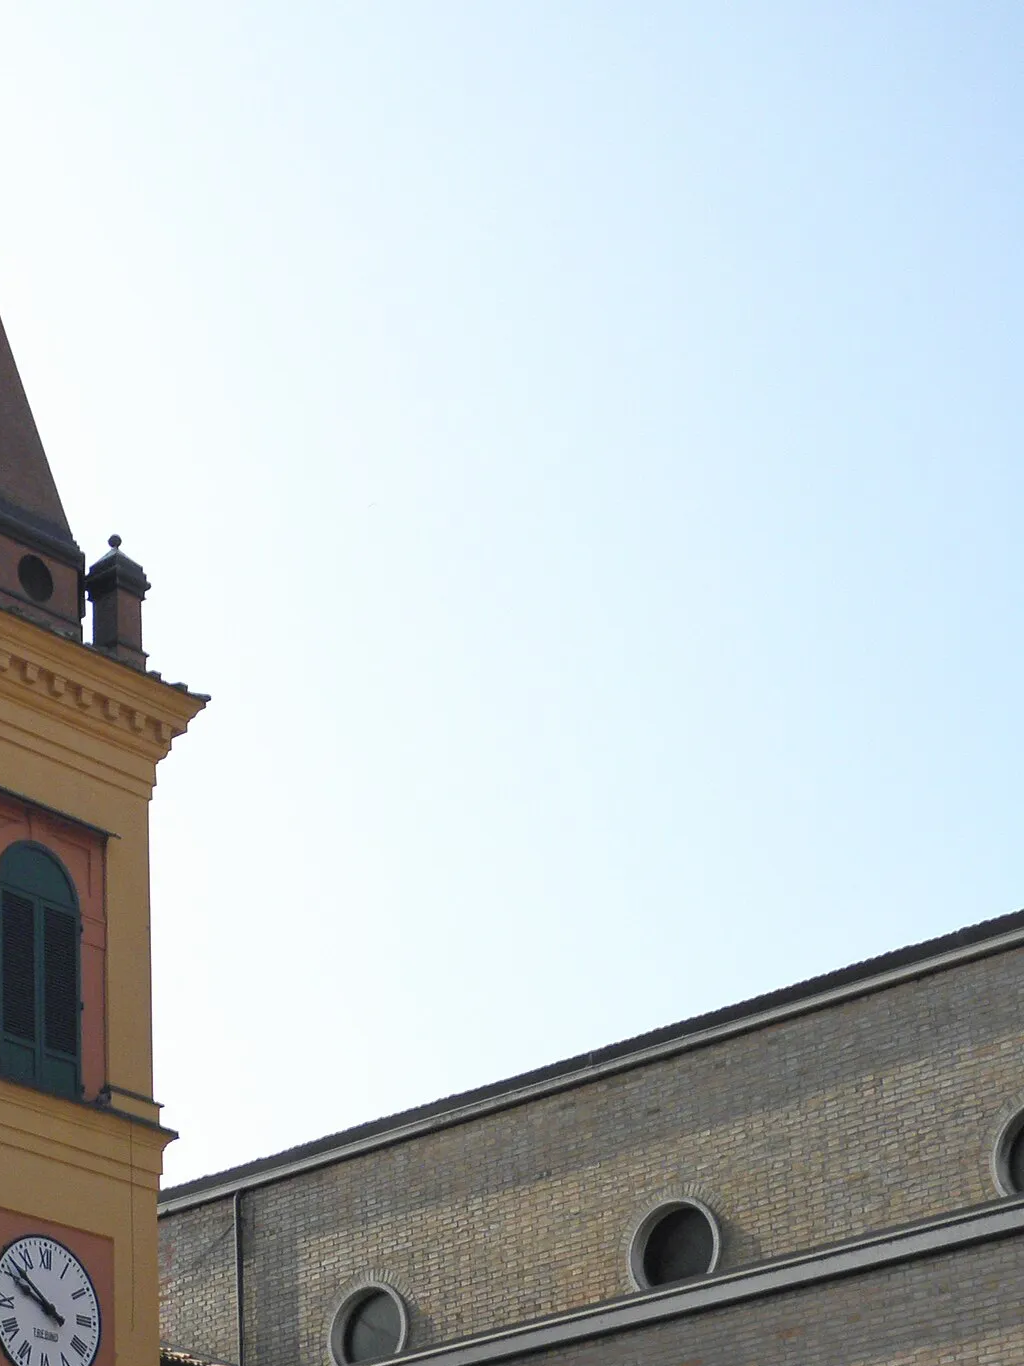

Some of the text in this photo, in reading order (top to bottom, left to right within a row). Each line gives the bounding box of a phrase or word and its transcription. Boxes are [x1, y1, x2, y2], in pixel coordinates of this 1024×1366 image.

[18, 1248, 34, 1271] XI
[39, 1246, 52, 1271] XII
[59, 1262, 70, 1280] I
[71, 1287, 87, 1300] II
[1, 1317, 20, 1342] VIII
[76, 1314, 92, 1328] III
[17, 1339, 32, 1365] VII
[70, 1334, 88, 1358] IIII
